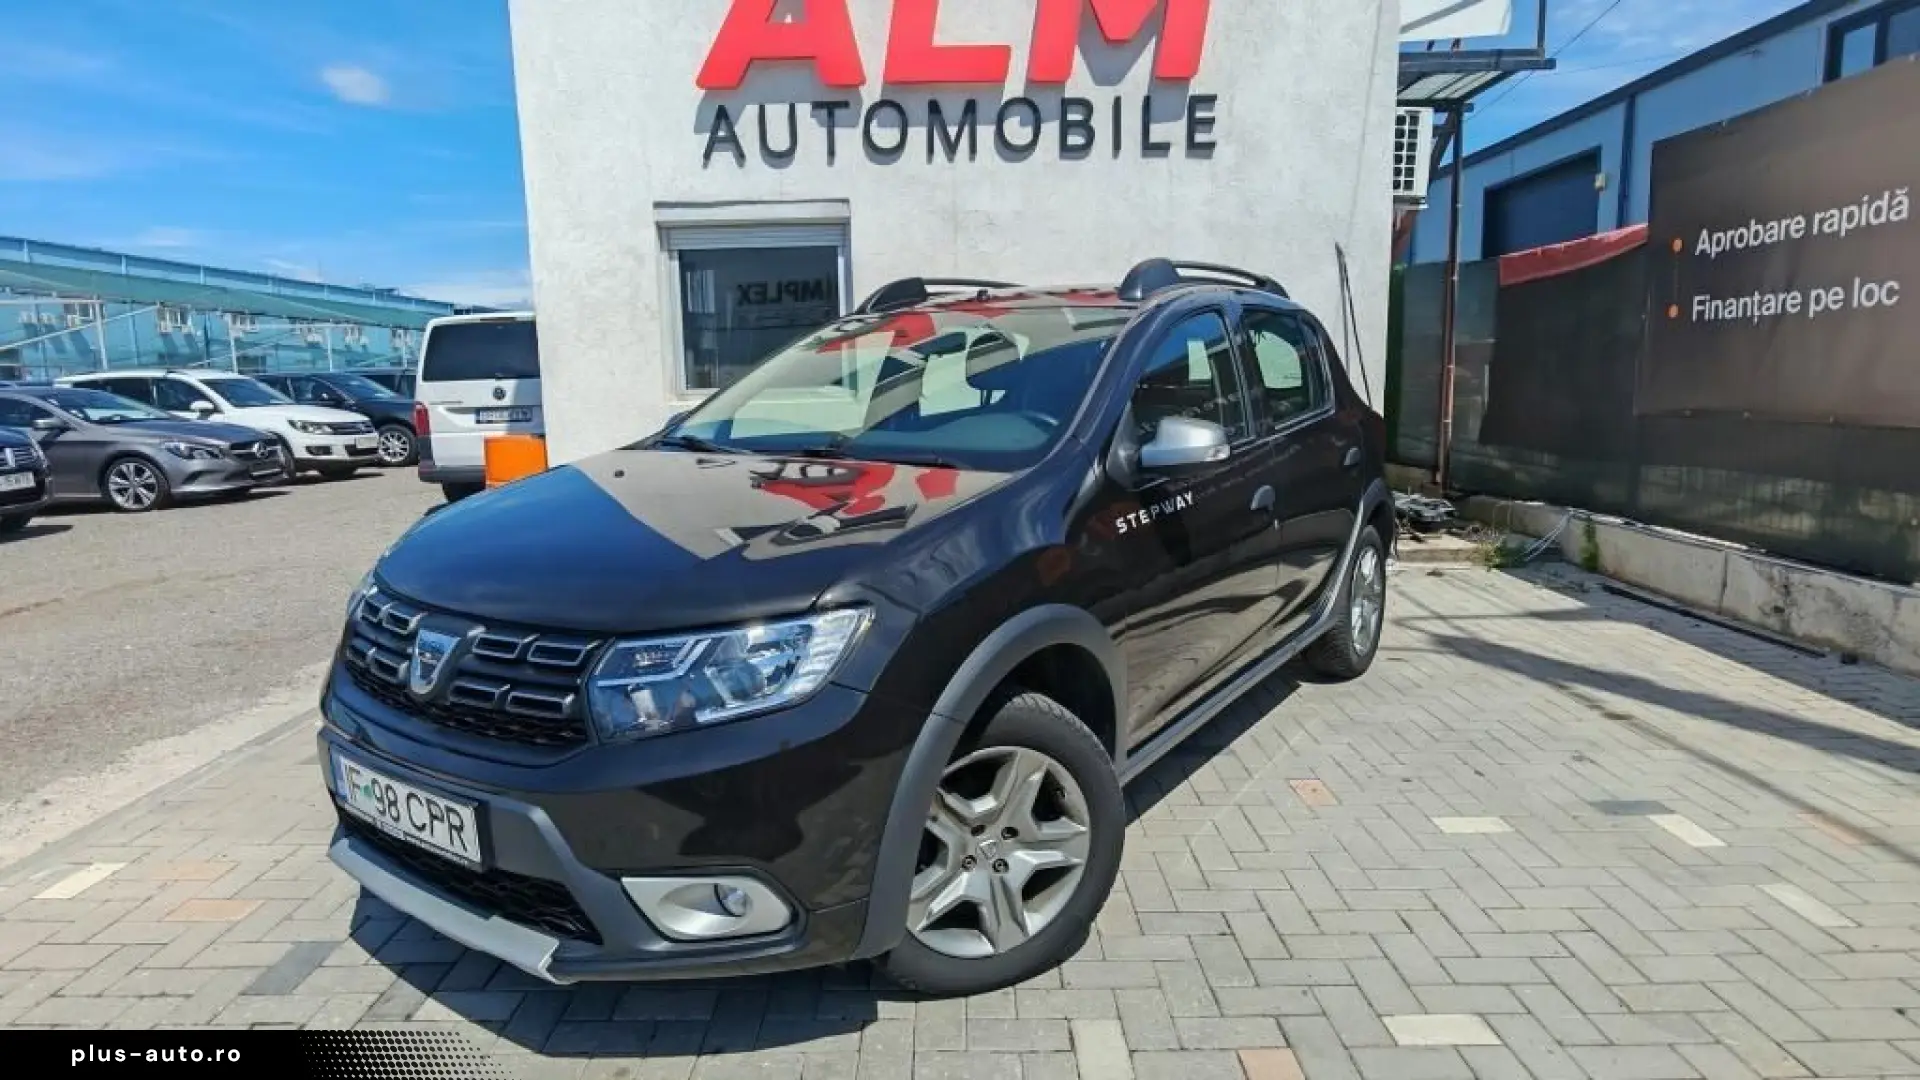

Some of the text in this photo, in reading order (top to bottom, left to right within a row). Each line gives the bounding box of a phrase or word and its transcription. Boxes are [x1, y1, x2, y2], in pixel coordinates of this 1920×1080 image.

[696, 0, 1210, 89] ALM
[702, 94, 1217, 166] AUTOMOBILE
[1695, 186, 1910, 259] Aprobare rapidă
[1808, 285, 1845, 318] pe
[1852, 277, 1900, 308] loc
[1115, 490, 1193, 534] STEPWAY
[370, 777, 400, 823] 98
[406, 792, 468, 852] CPR
